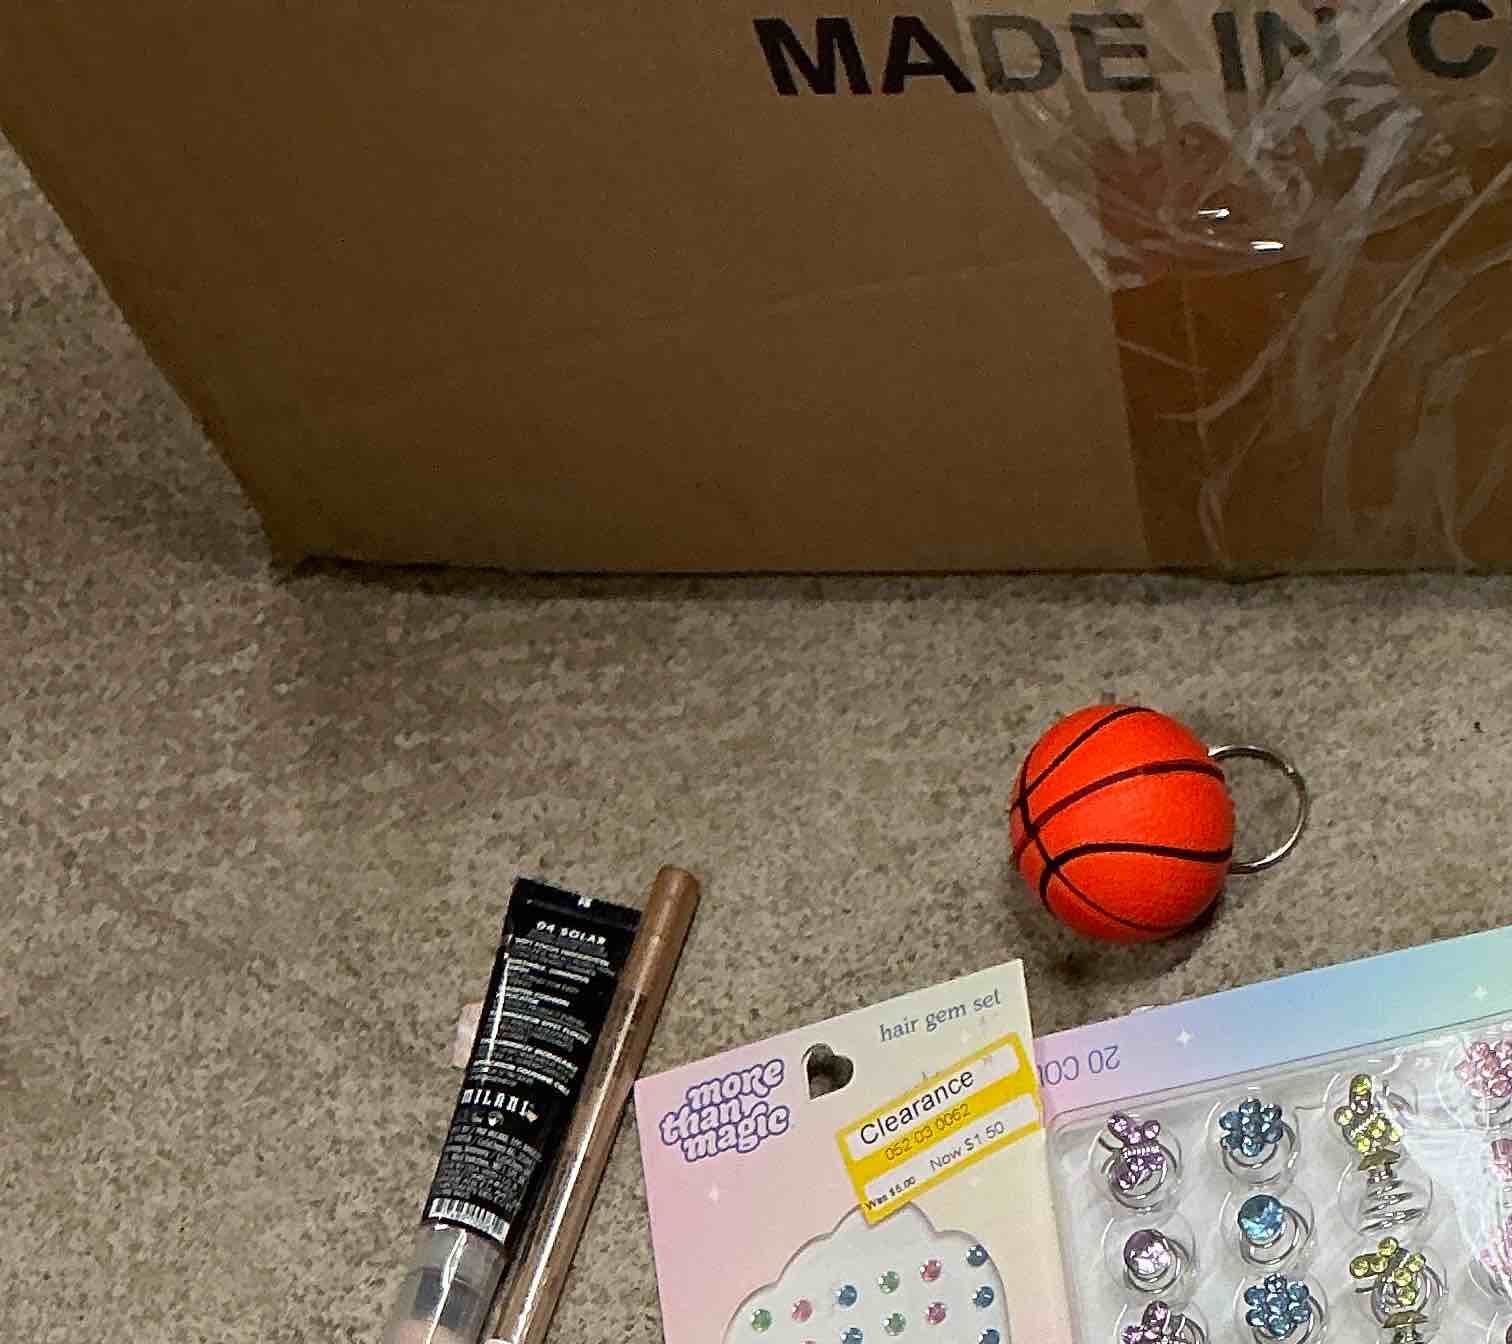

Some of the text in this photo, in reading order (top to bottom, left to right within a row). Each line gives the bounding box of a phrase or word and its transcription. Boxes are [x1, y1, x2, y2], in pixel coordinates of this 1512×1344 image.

[752, 12, 1158, 98] MADE
[1221, 5, 1346, 91] IN
[878, 988, 1001, 1042] hair gem set
[687, 1058, 784, 1103] more
[1087, 1045, 1120, 1074] 20
[460, 1088, 529, 1116] MILANI
[659, 1100, 745, 1146] than
[859, 1068, 975, 1146] Clearance
[682, 1105, 791, 1162] magic
[929, 1145, 962, 1172] Now
